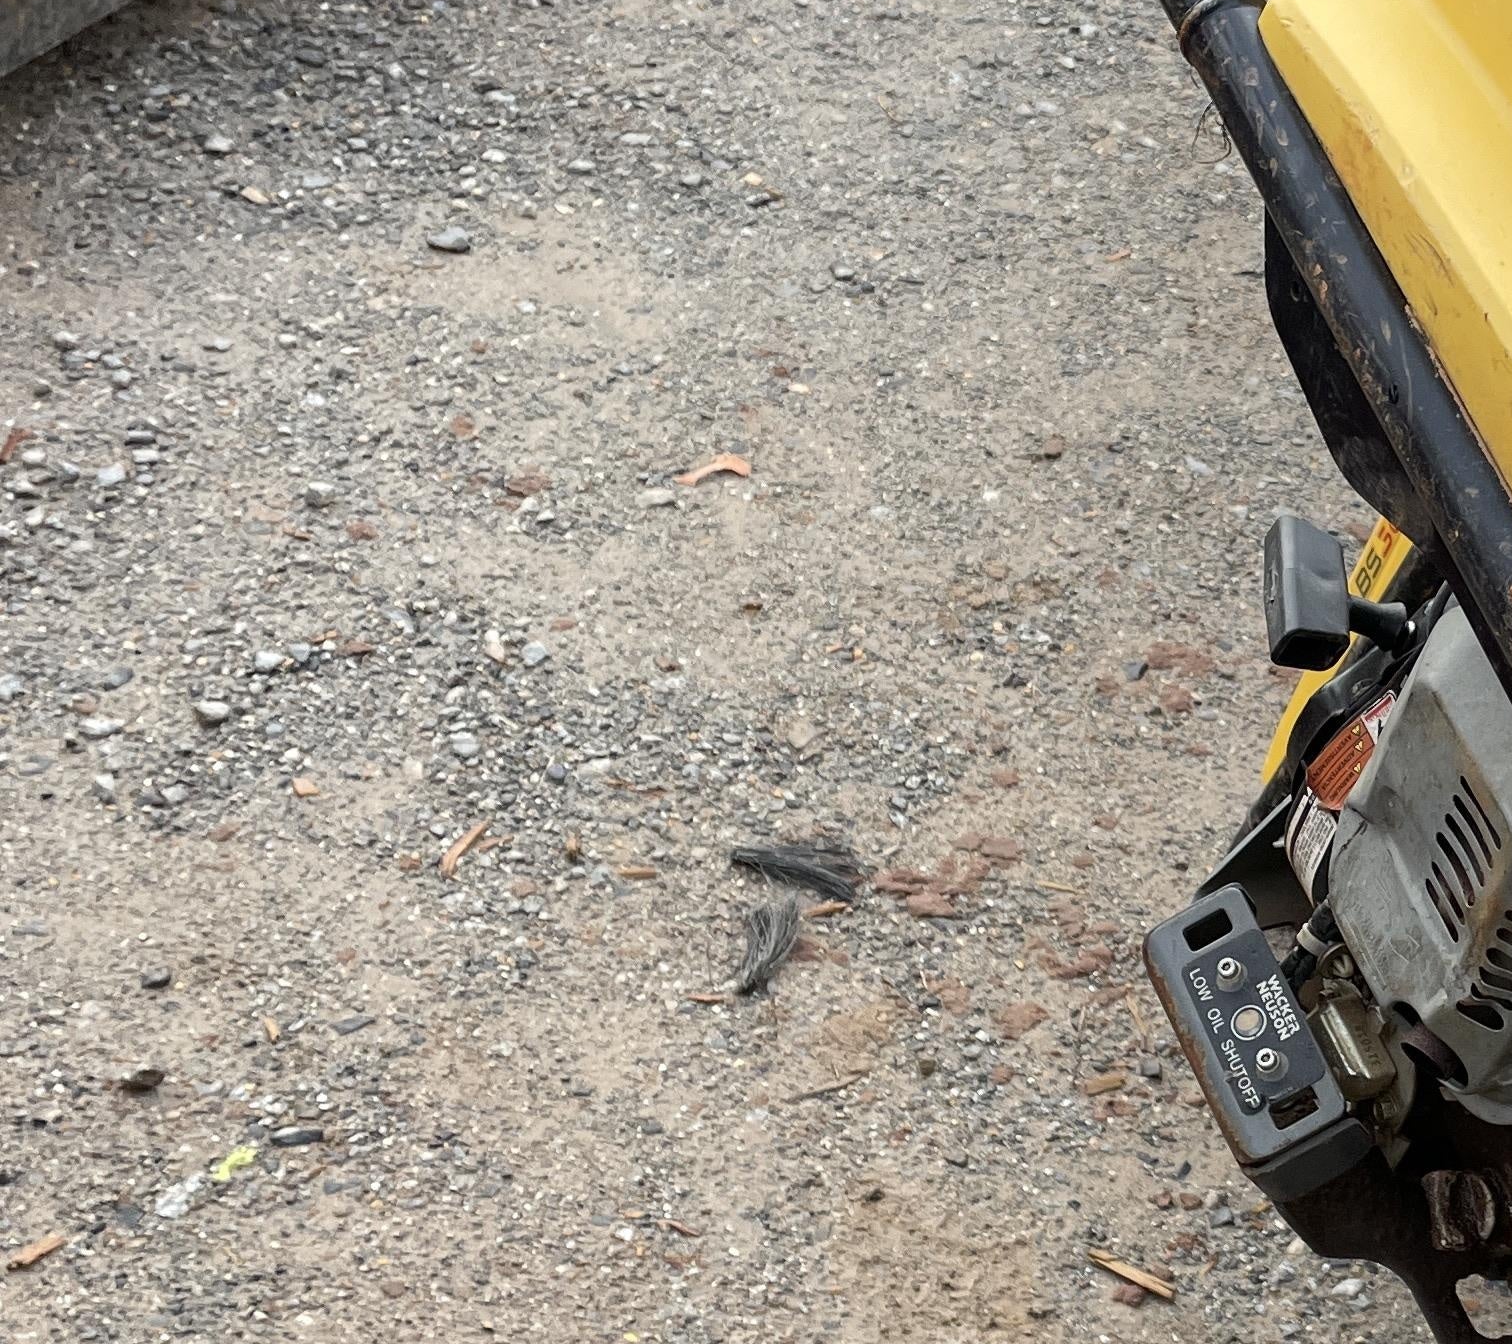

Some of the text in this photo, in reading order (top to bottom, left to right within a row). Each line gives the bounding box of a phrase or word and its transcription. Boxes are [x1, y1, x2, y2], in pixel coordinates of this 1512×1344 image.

[1256, 980, 1292, 1042] NEUSON
[1267, 973, 1300, 1037] WACKER
[1189, 967, 1261, 1109] LOW OIL SHUTOFF
